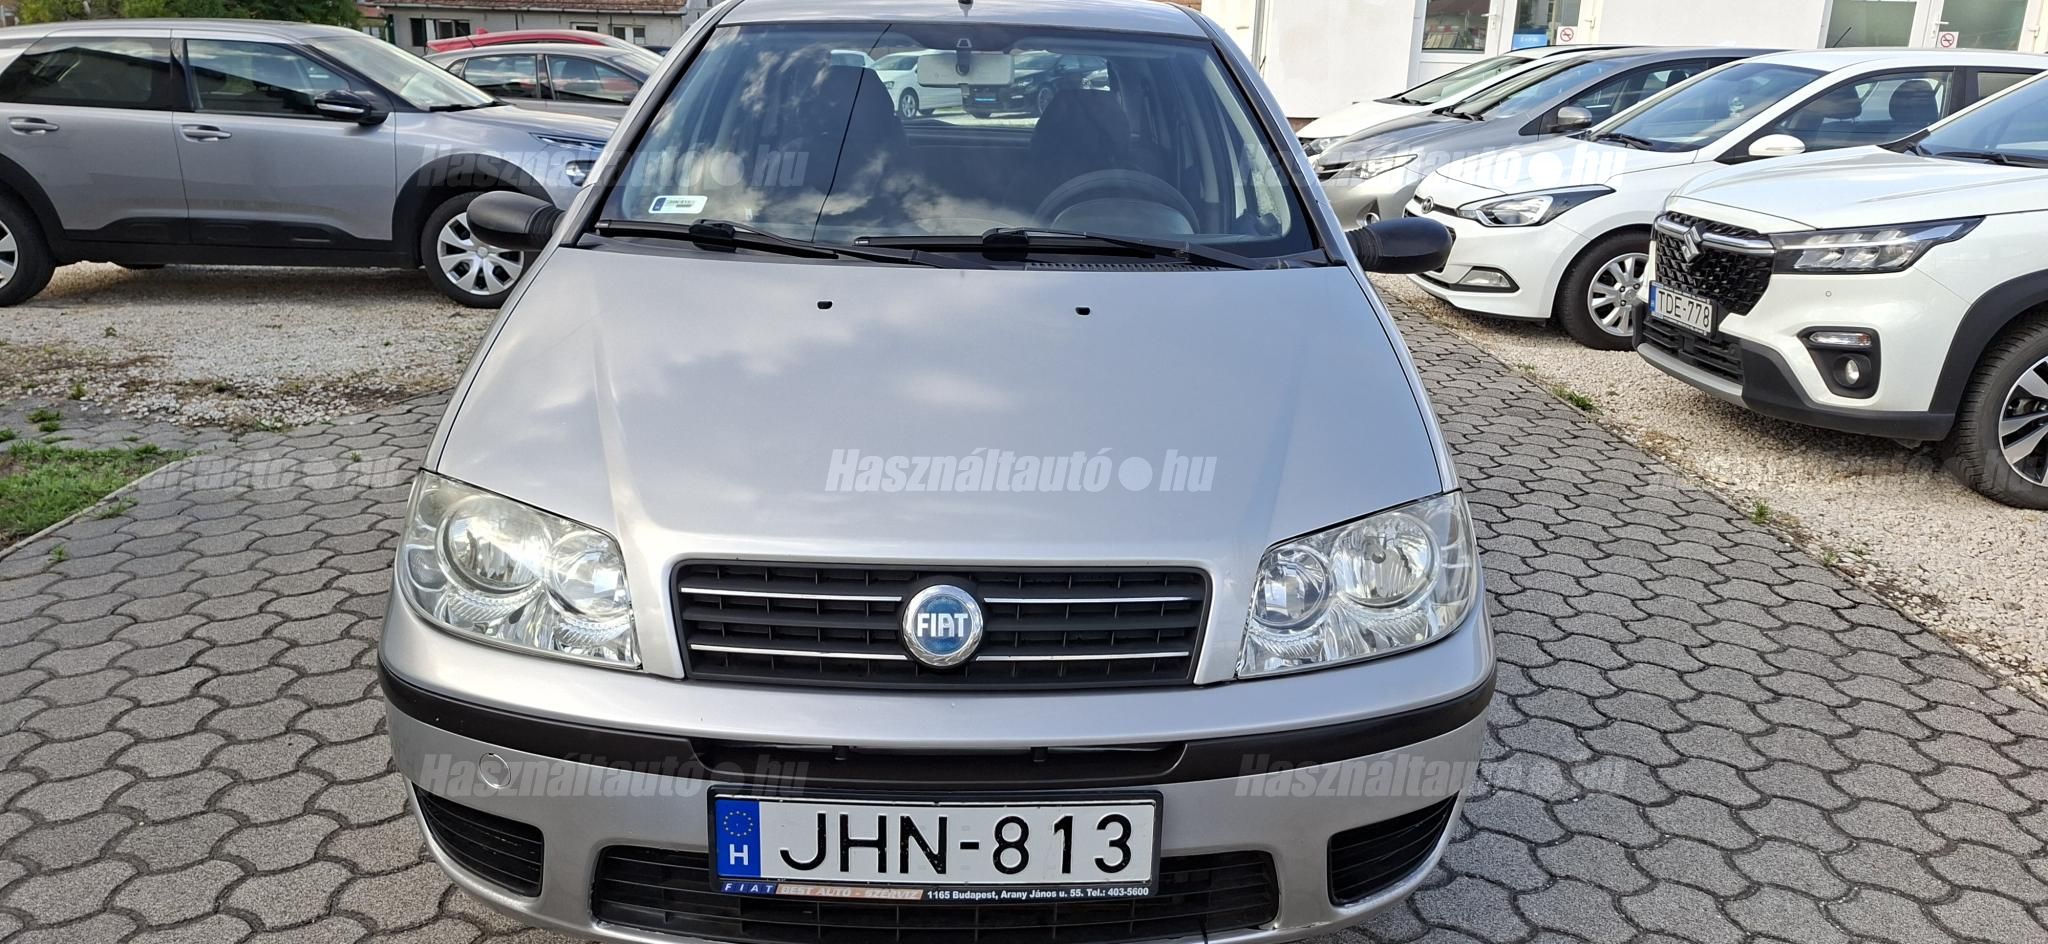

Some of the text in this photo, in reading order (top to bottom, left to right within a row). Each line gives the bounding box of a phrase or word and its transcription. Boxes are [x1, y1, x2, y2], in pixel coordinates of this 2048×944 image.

[1659, 291, 1710, 328] TDE-778
[917, 613, 968, 637] FIAT
[728, 844, 750, 866] H
[779, 812, 1132, 875] JHN-813
[724, 883, 774, 894] FIAT
[781, 885, 814, 895] BEST
[927, 890, 950, 900] 1165
[952, 890, 999, 901] Budapest,
[1000, 890, 1028, 900] Arany
[1029, 889, 1057, 899] János
[1058, 890, 1068, 898] u.
[1069, 888, 1085, 898] 55.
[1107, 887, 1150, 897] 403-5600
